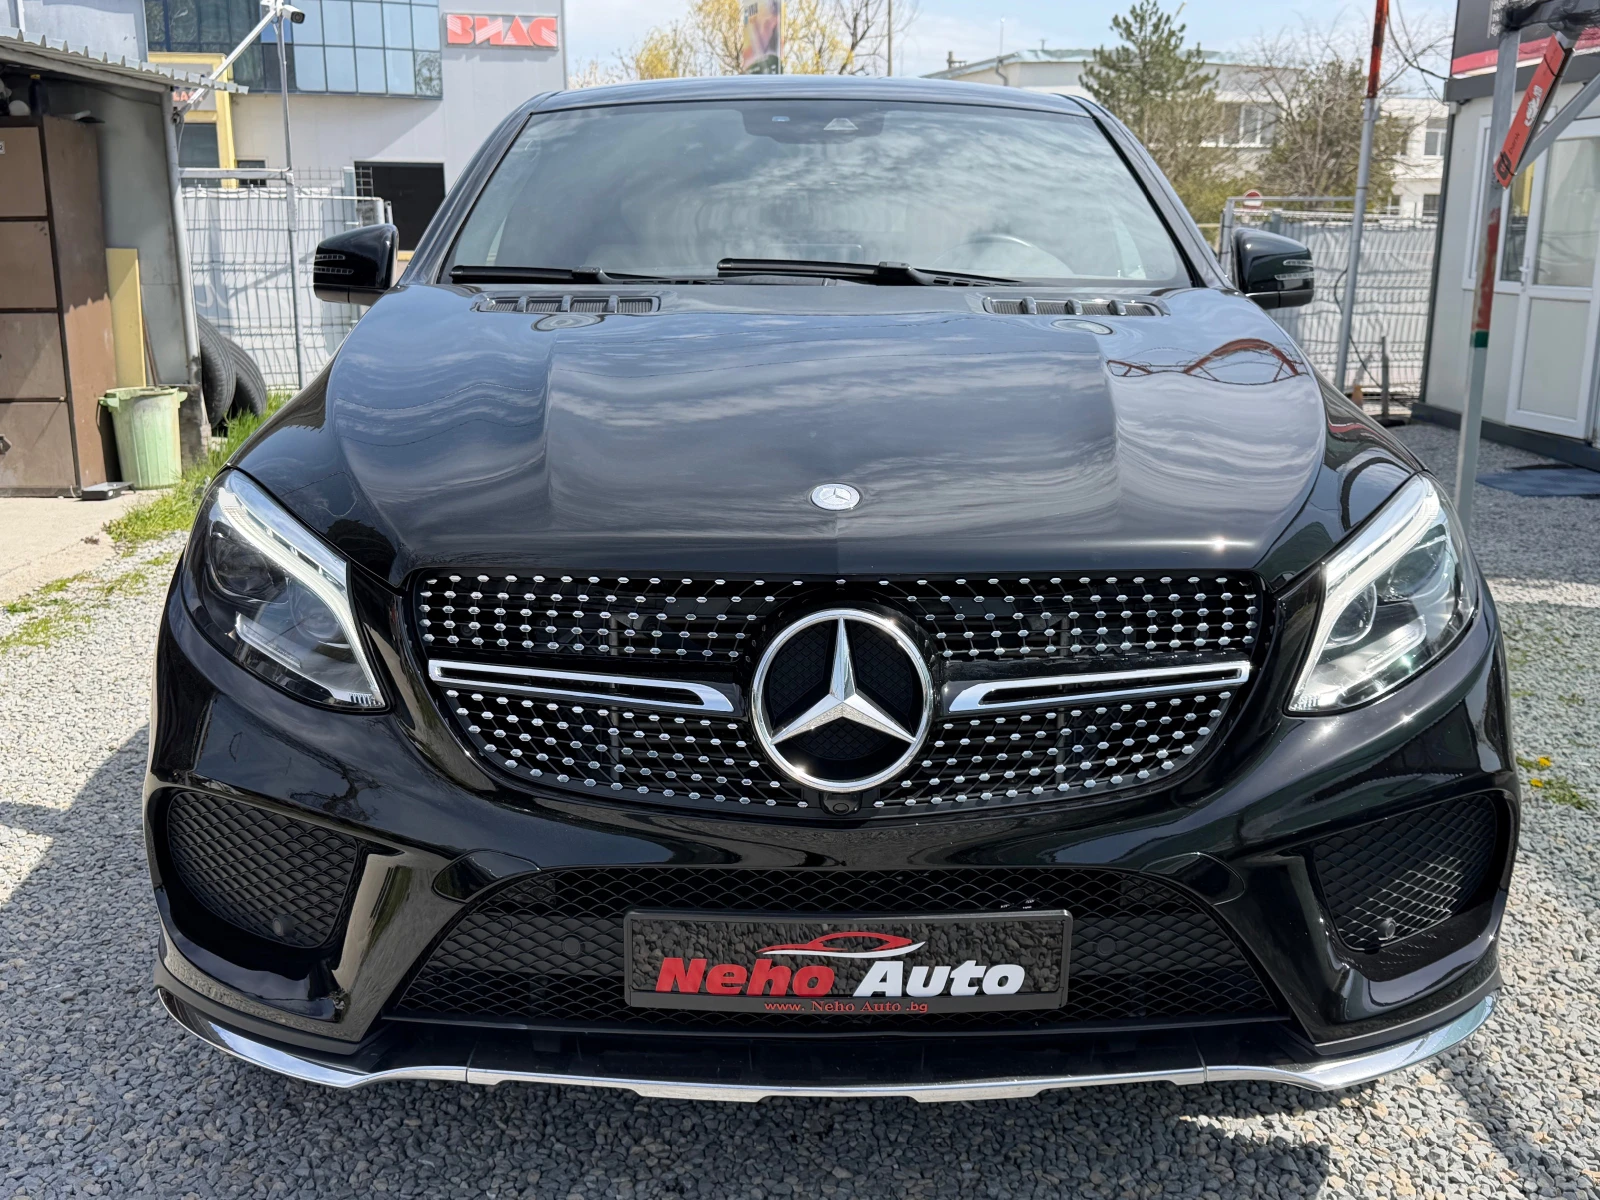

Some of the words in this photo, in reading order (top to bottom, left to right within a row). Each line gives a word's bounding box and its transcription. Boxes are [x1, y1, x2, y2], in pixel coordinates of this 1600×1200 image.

[655, 957, 835, 997] Neho
[852, 960, 1026, 997] Auto
[811, 1000, 856, 1012] Neho
[860, 1001, 901, 1012] Auto
